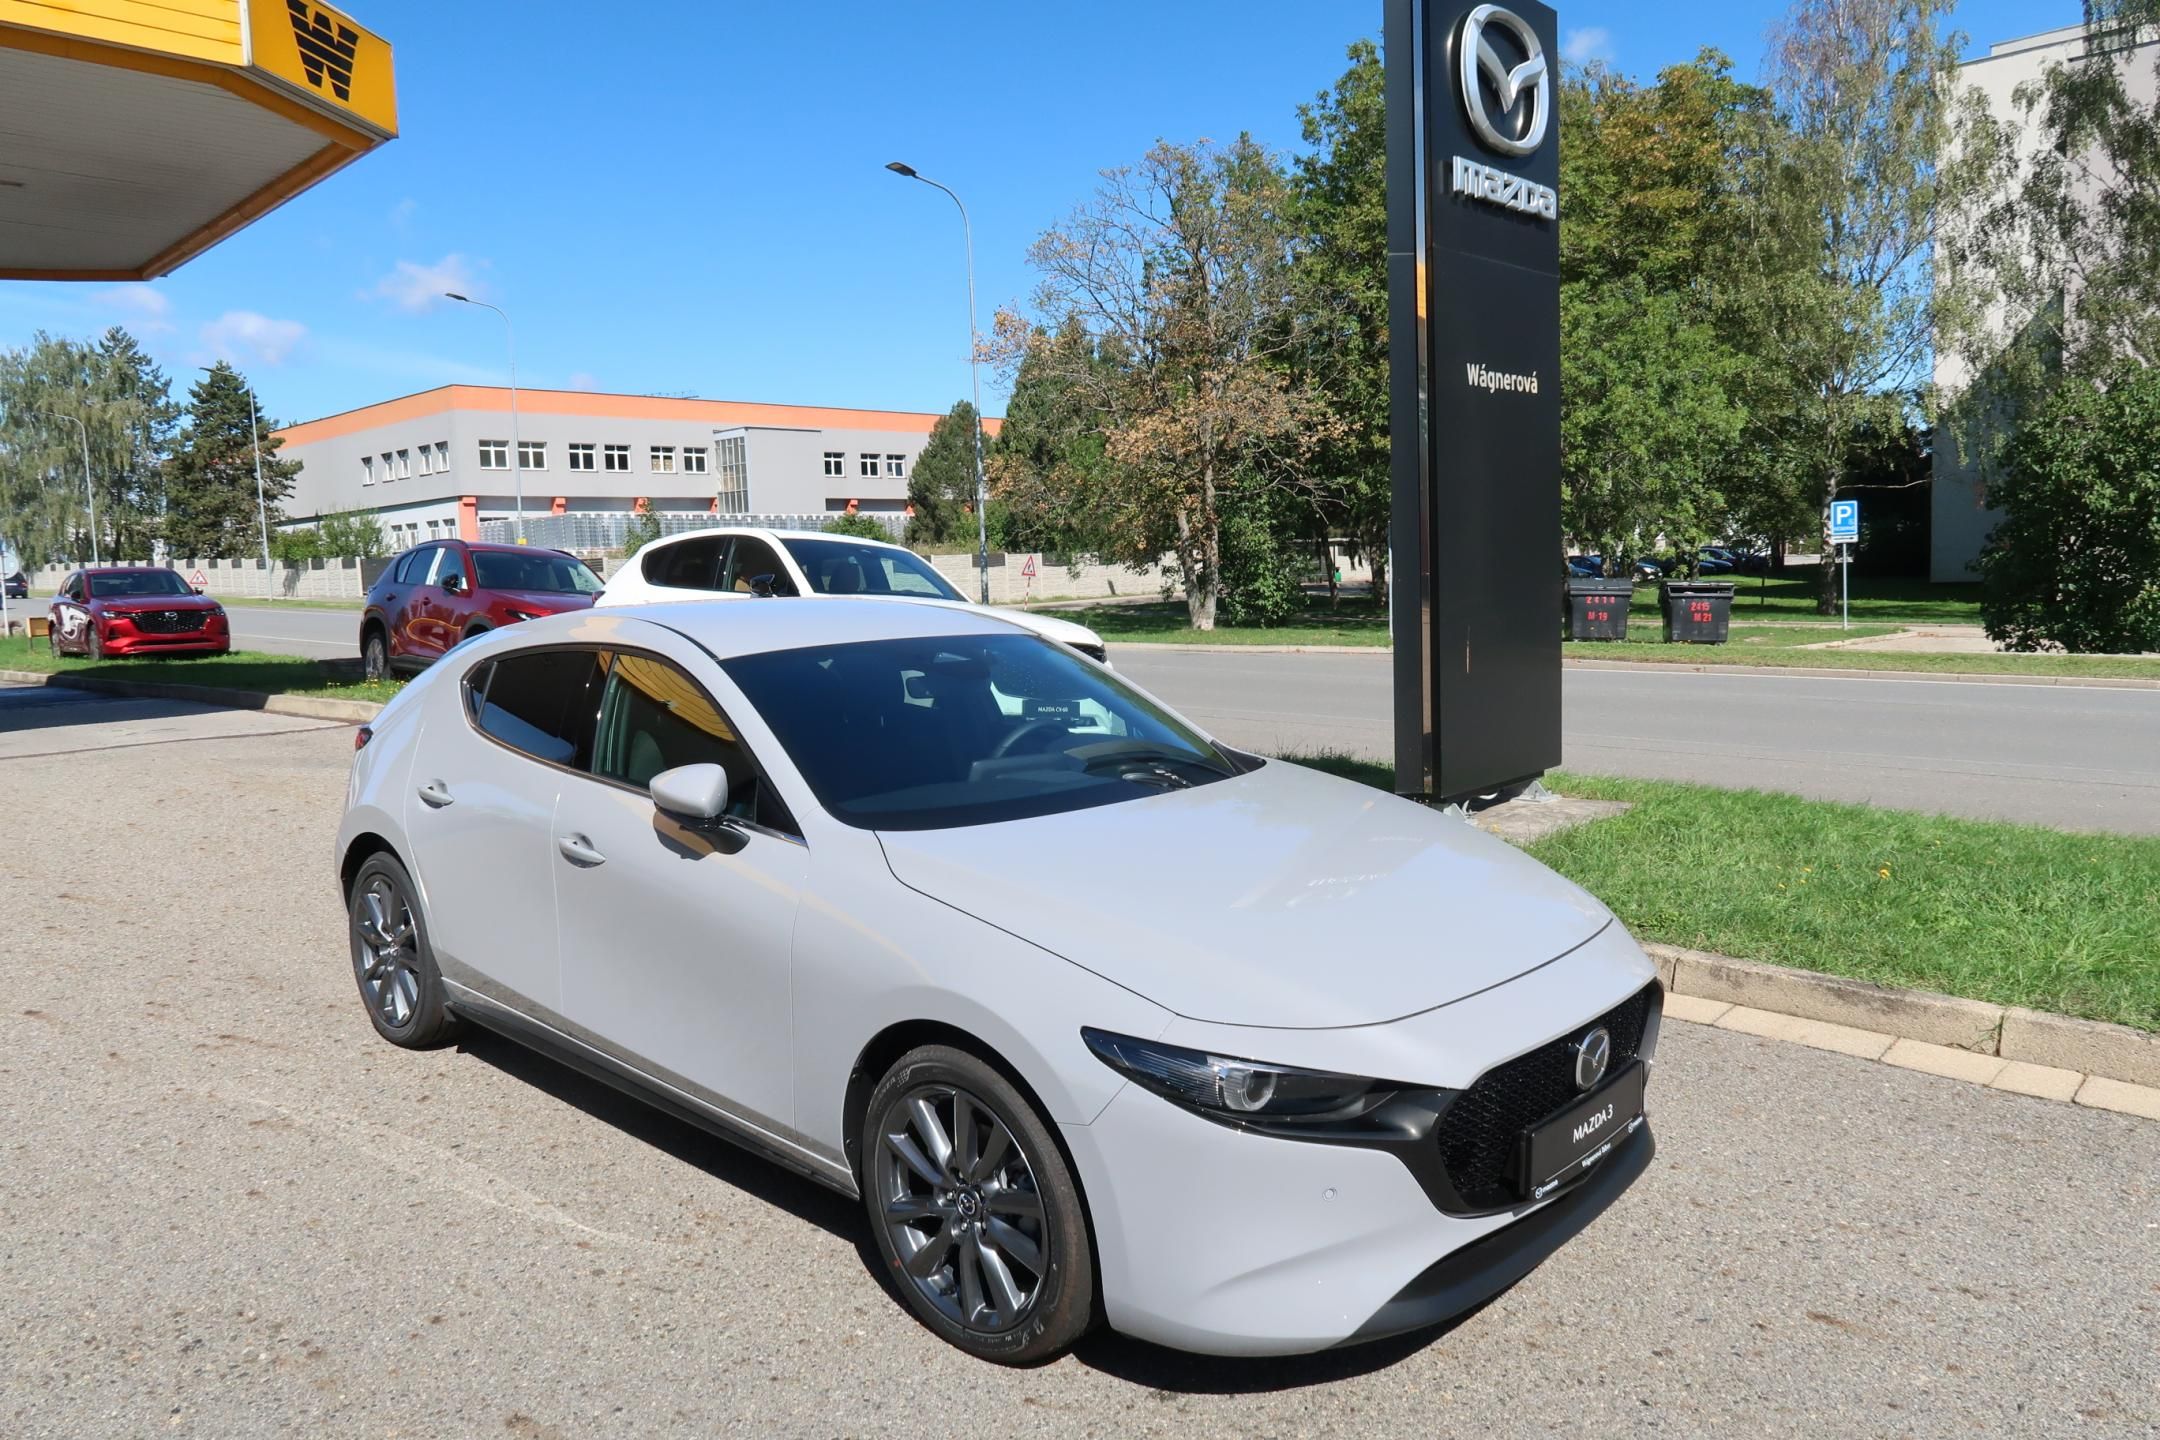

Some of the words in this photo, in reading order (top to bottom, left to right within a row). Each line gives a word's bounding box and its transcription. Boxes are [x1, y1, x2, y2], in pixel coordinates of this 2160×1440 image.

[1466, 362, 1538, 394] Wágnerová
[1836, 505, 1851, 525] P
[1573, 1109, 1607, 1144] MAZDA
[1607, 1103, 1613, 1119] 3
